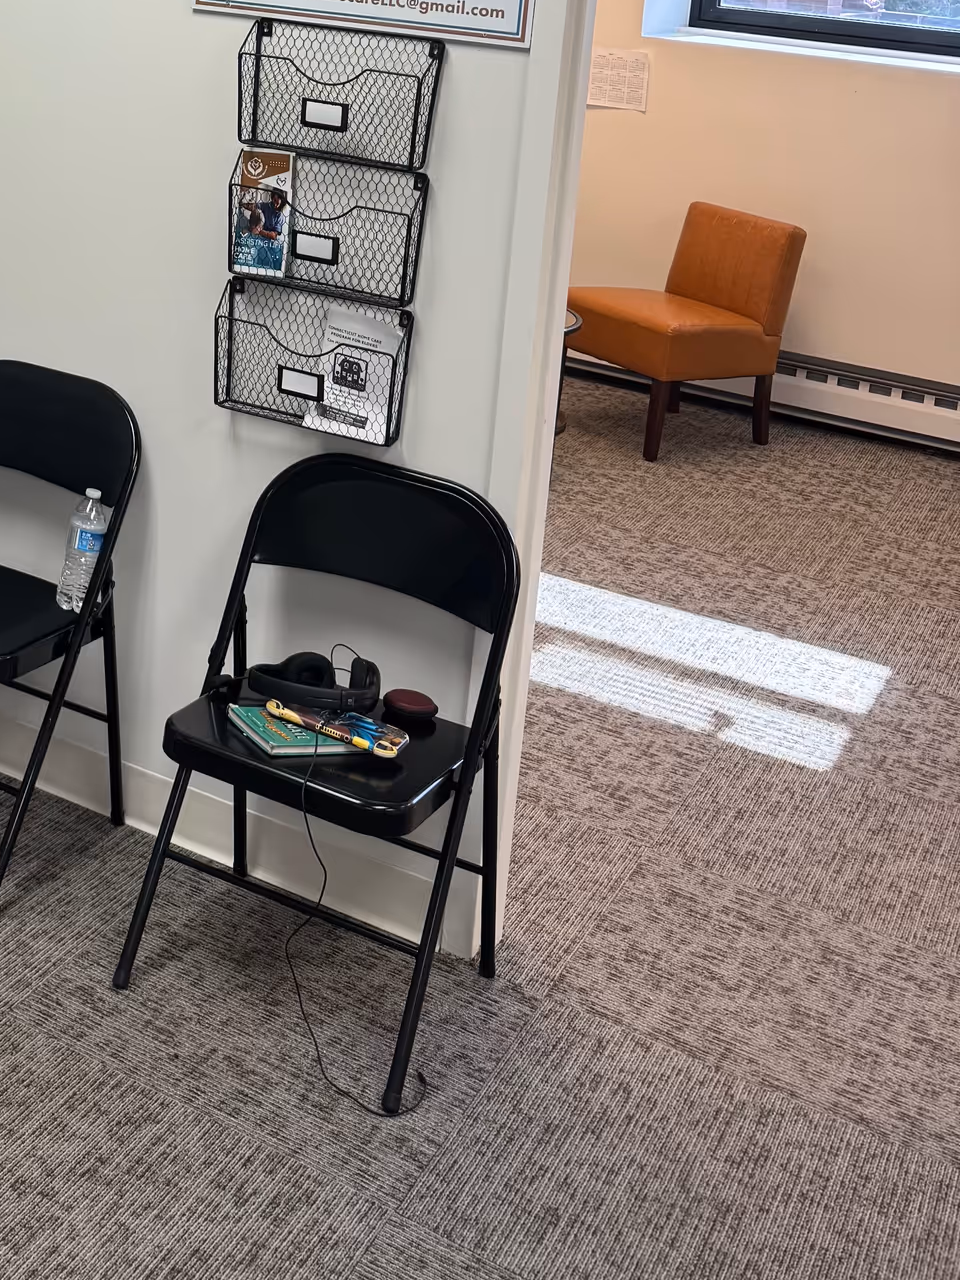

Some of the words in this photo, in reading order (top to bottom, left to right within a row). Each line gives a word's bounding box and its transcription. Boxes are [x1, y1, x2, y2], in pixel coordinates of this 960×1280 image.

[328, 324, 357, 336] CONNECTICUT
[331, 331, 351, 341] PROGRAM
[362, 340, 378, 348] ELDERS
